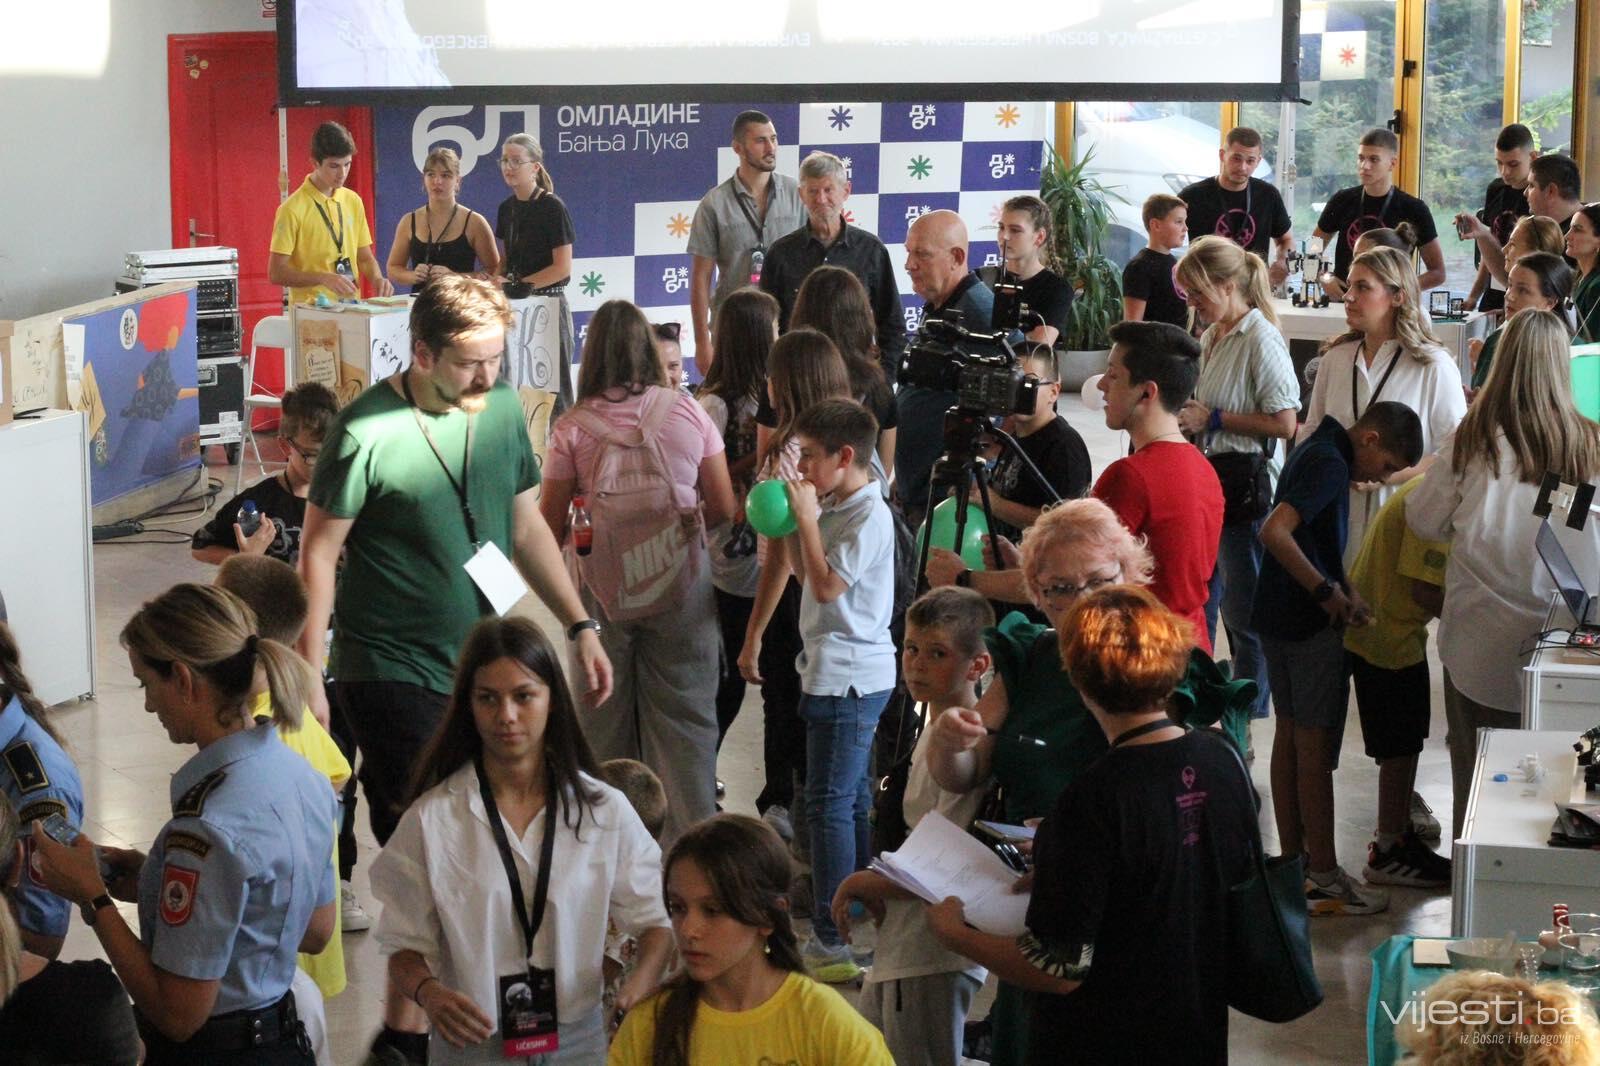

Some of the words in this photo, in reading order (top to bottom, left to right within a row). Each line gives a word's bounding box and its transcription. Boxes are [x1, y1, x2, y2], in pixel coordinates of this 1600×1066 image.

[556, 103, 700, 128] ОМЛАДИНЕ
[558, 131, 626, 153] Бања
[632, 129, 690, 154] Лука
